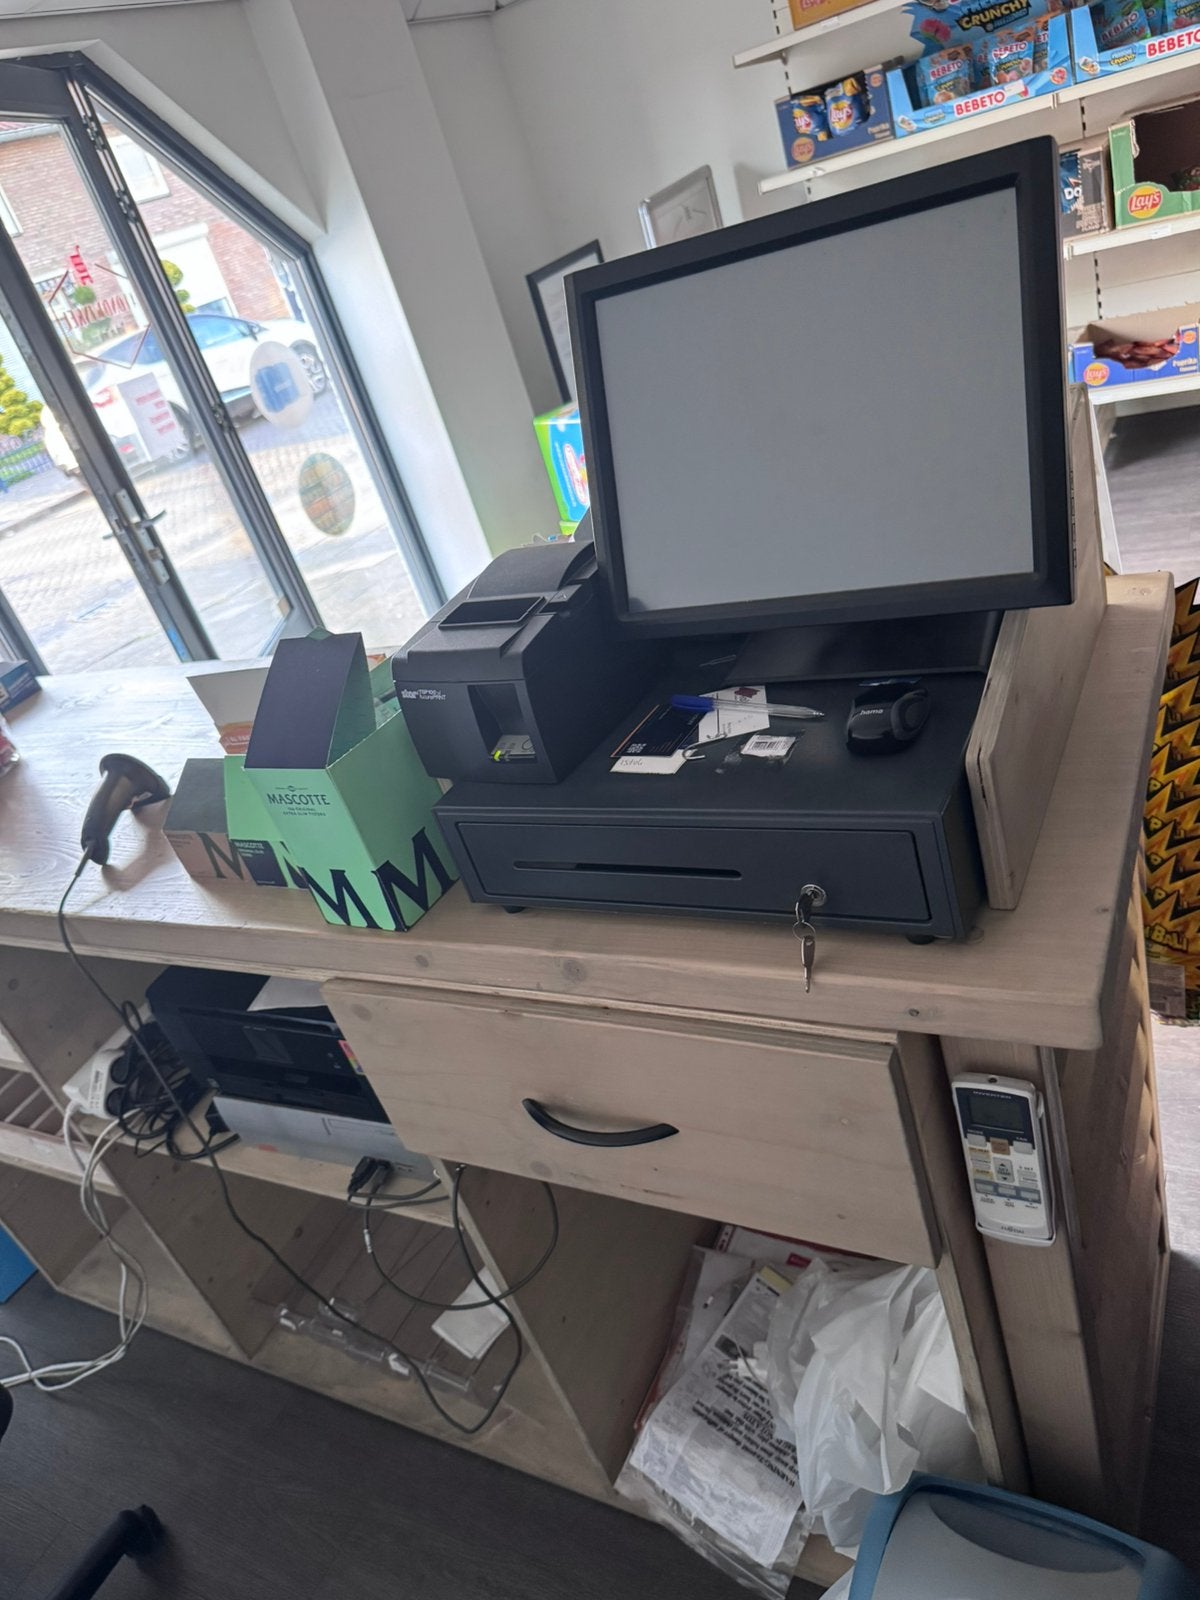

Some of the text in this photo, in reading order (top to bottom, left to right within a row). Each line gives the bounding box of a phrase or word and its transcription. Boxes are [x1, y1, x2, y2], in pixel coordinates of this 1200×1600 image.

[930, 60, 963, 80] BEBETO
[955, 91, 1006, 116] BEBETO
[1131, 191, 1162, 212] Lay's
[266, 793, 330, 805] MASCOTTE
